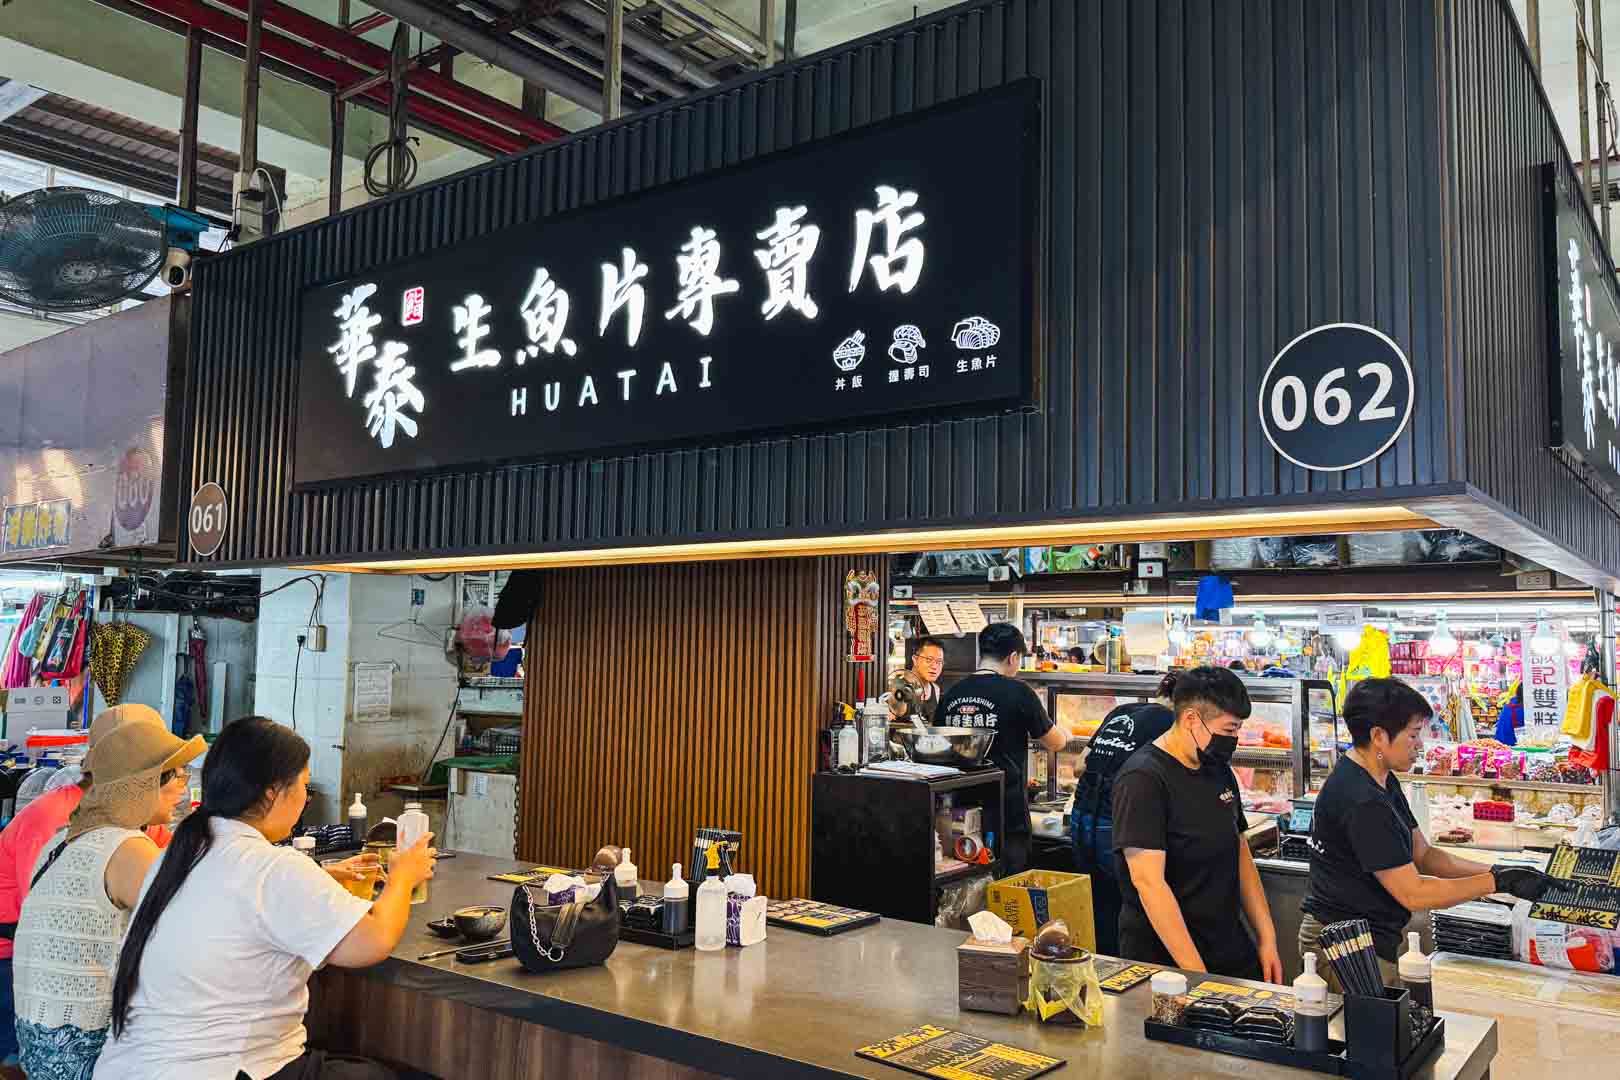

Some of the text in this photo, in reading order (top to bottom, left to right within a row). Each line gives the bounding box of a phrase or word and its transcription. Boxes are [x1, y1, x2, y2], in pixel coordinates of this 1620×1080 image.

[450, 185, 926, 372] 生魚片專賣店
[328, 283, 425, 449] 華泰
[511, 356, 713, 417] HUATAI
[956, 354, 998, 373] 生魚片
[1271, 362, 1396, 432] 062
[192, 503, 224, 534] 061
